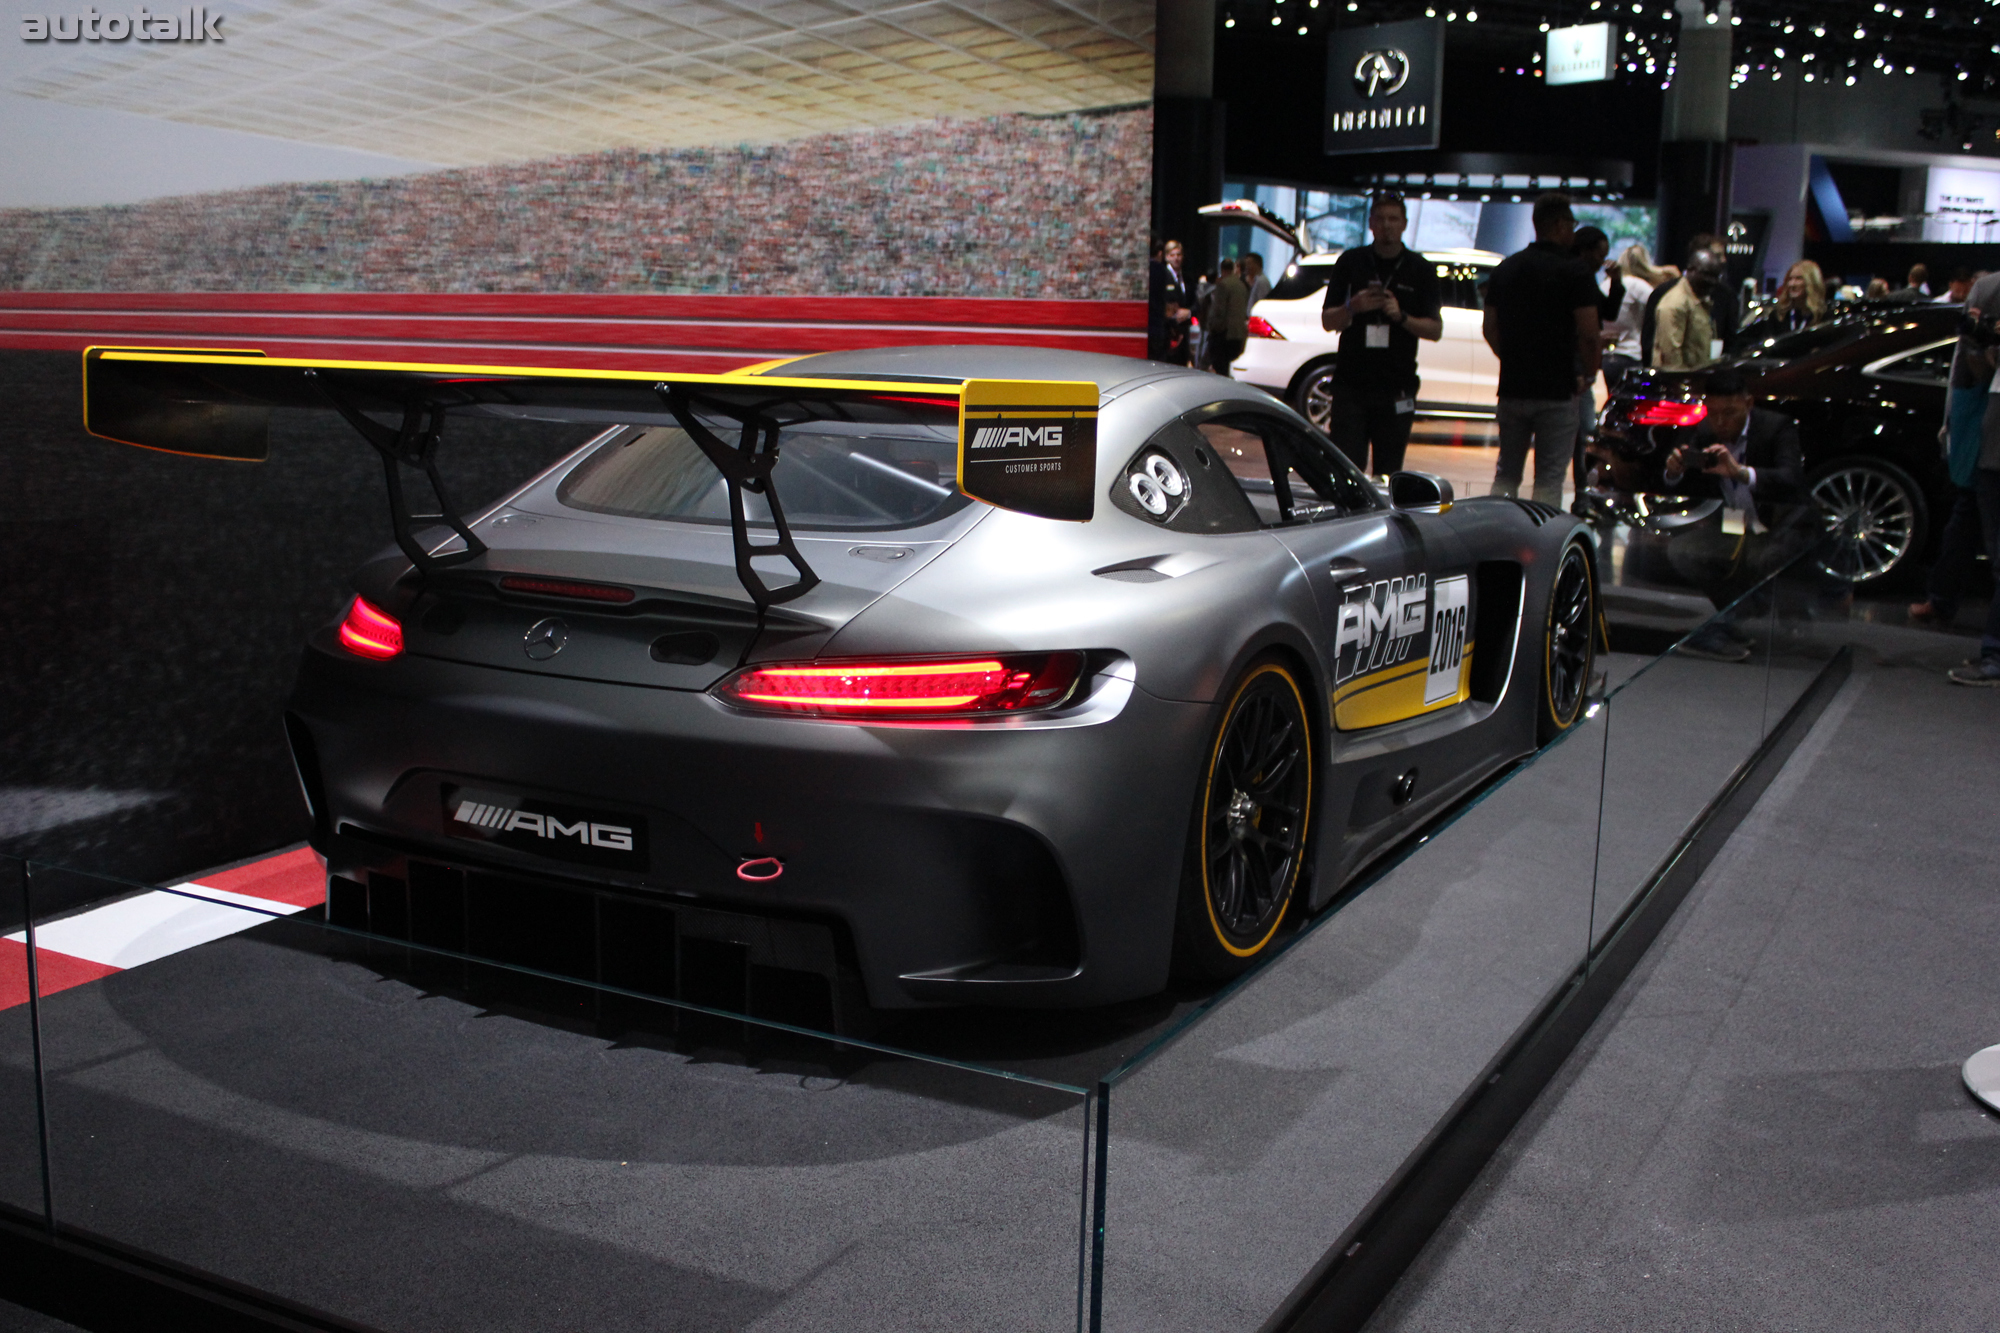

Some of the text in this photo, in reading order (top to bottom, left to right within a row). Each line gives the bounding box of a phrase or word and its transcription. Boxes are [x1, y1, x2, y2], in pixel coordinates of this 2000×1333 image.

[1333, 105, 1426, 132] INFINITI
[1001, 426, 1063, 448] AMG
[1005, 462, 1062, 474] CUSTOMER SPORTS
[1334, 587, 1427, 659] AMG
[1430, 605, 1466, 676] 2016
[504, 810, 633, 851] AMG
